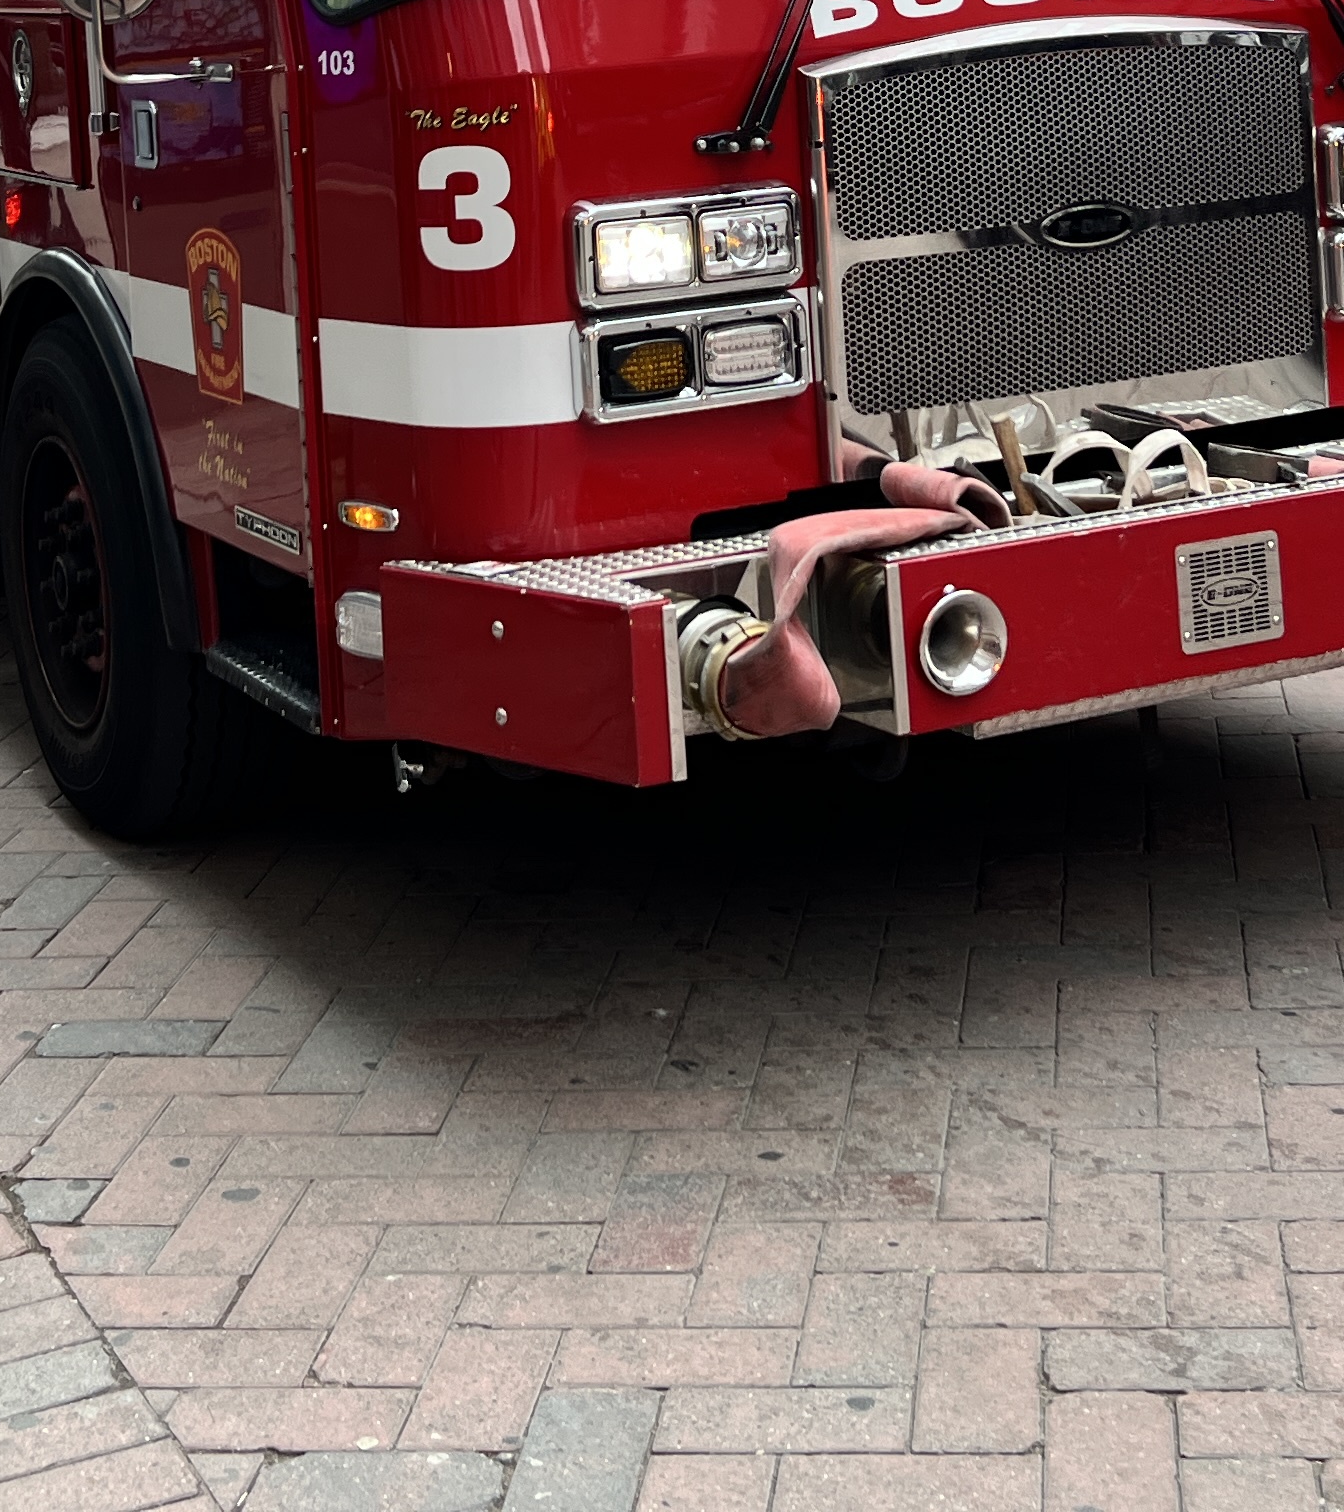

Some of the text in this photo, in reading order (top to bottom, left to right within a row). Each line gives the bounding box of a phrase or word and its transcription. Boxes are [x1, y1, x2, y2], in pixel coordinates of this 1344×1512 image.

[317, 49, 355, 76] 103
[418, 144, 516, 272] 3
[188, 237, 239, 283] BOSTON
[236, 512, 298, 548] TYPHOON
